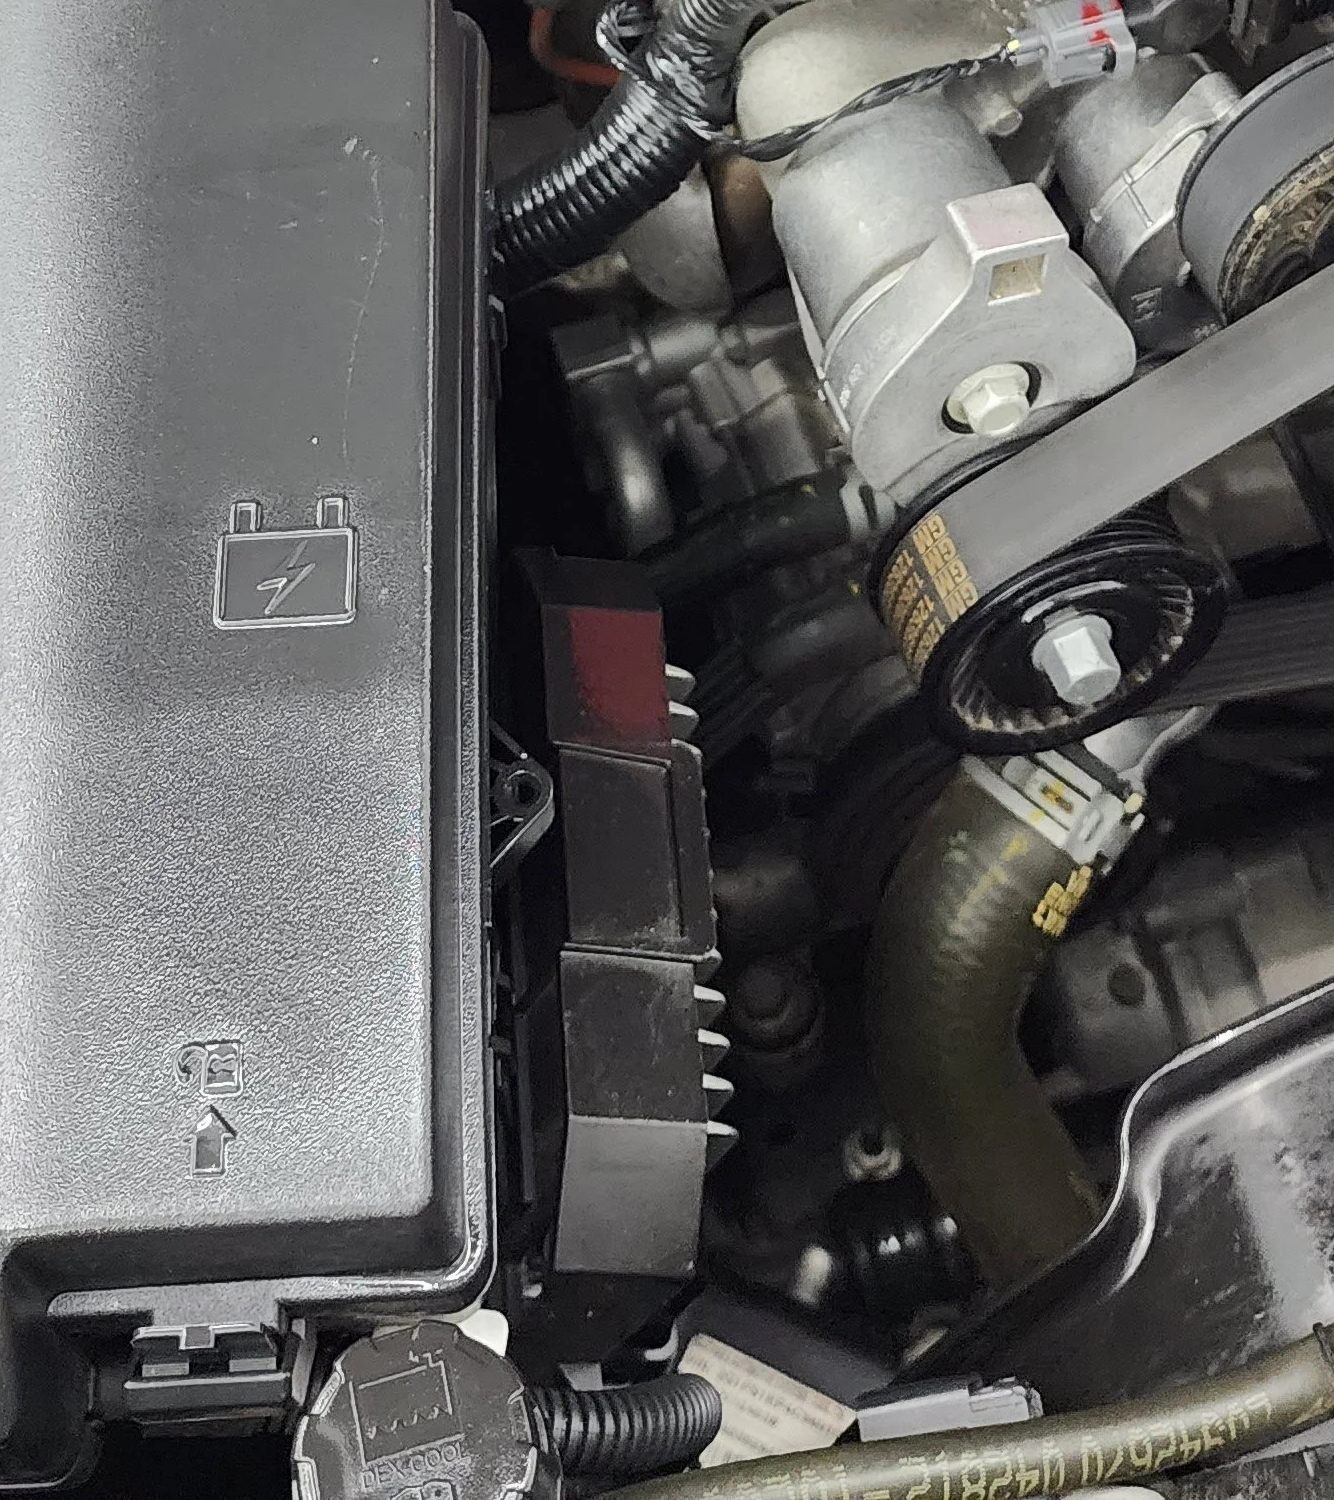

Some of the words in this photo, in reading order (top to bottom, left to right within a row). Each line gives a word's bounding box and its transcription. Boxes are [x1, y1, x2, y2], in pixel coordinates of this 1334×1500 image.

[912, 513, 947, 555] GM
[922, 535, 957, 577] GM
[932, 558, 968, 600] GM
[942, 580, 980, 623] GM
